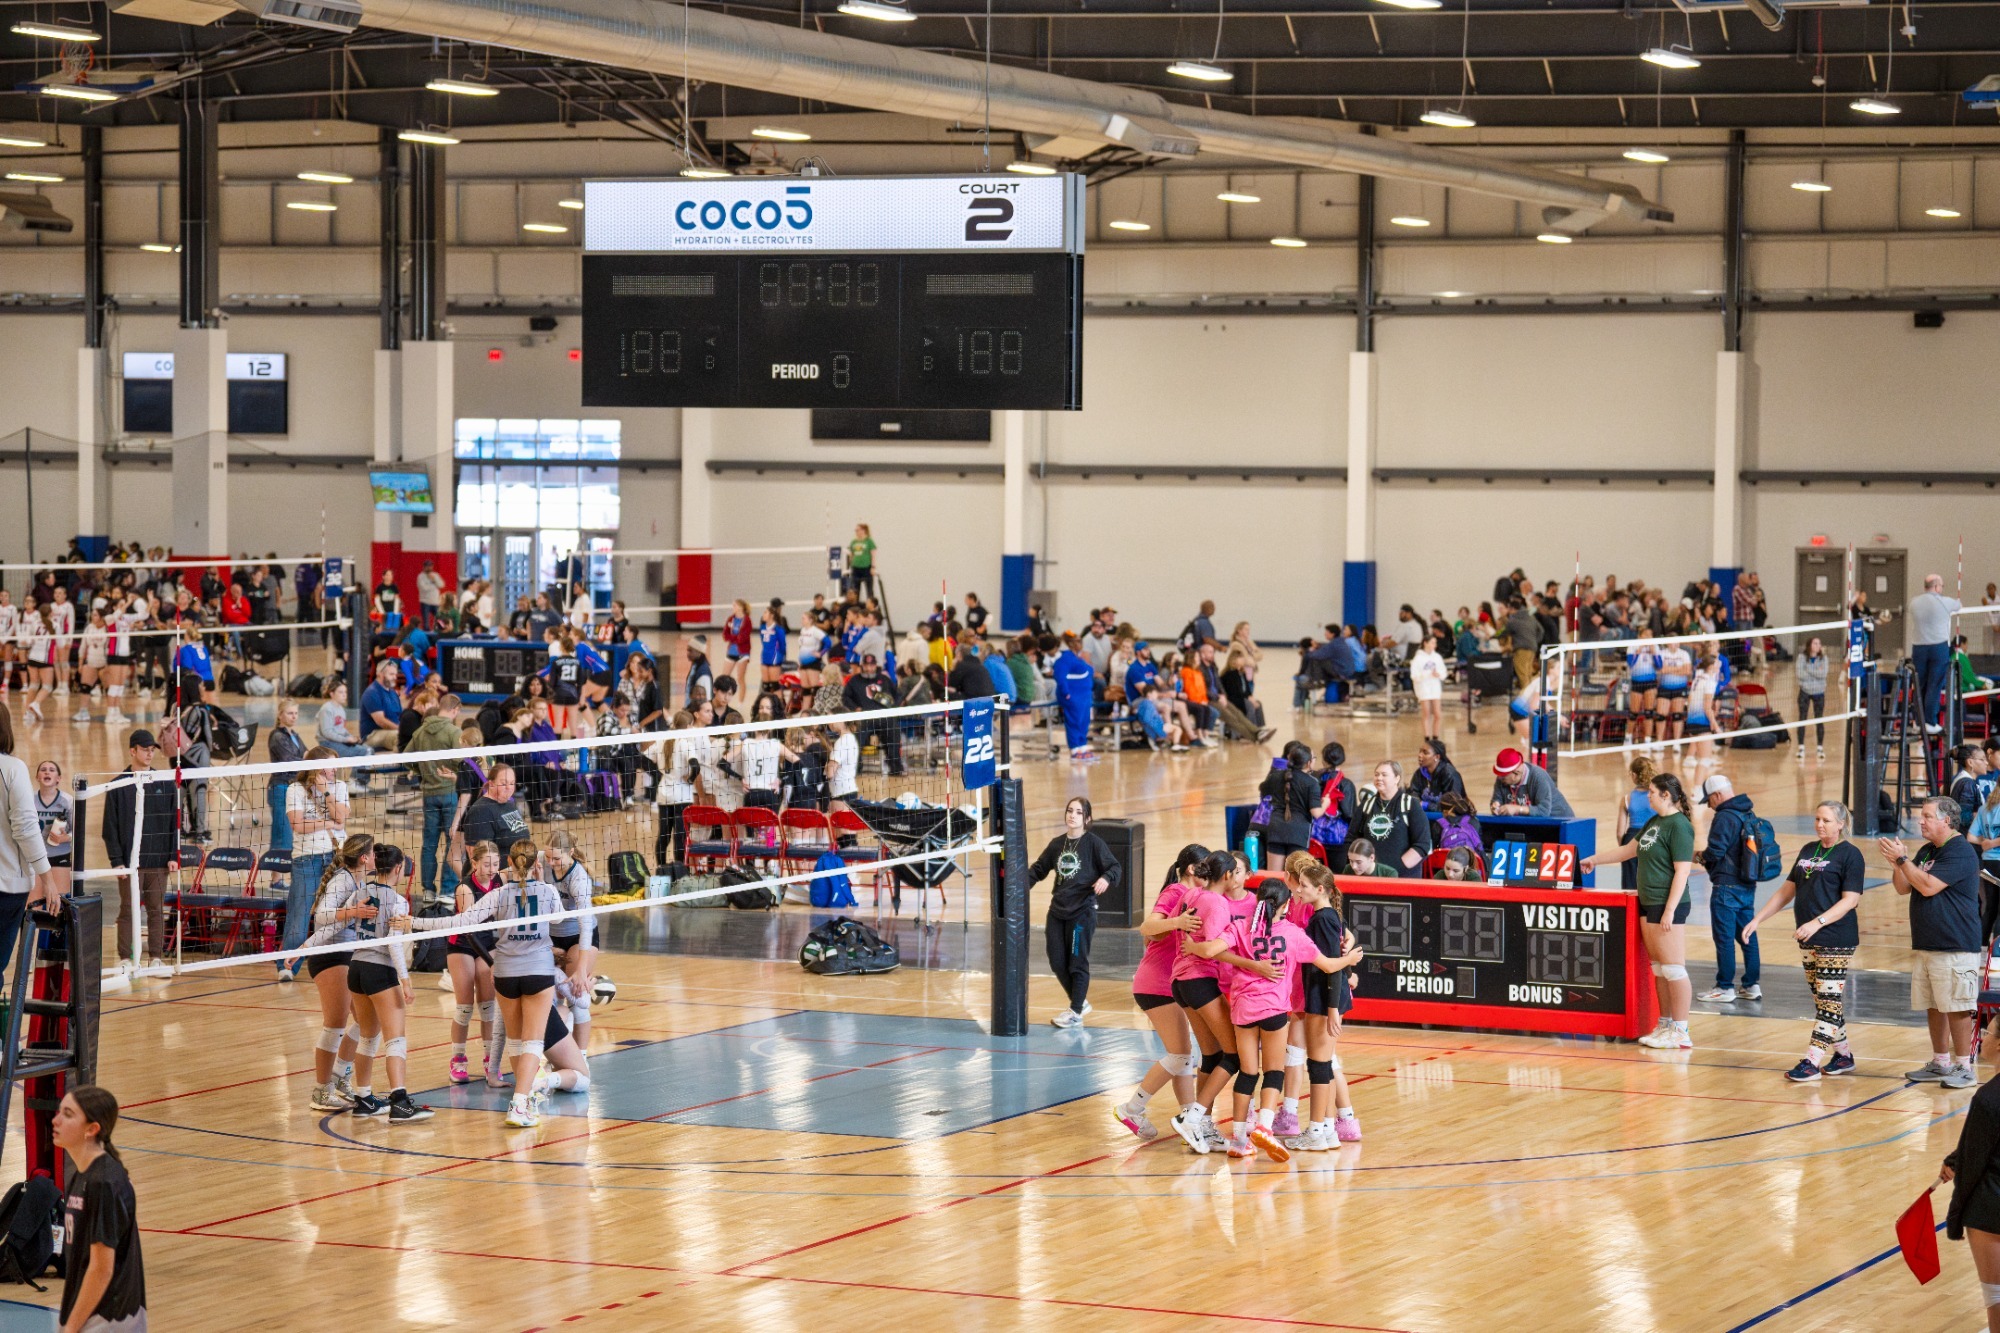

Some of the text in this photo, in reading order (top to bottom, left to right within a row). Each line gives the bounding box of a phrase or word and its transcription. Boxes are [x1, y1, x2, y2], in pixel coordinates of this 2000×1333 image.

[959, 183, 1020, 194] COURT
[965, 197, 1014, 241] 2
[674, 236, 731, 245] HYDRATION
[741, 236, 813, 244] ELECTROLYTES
[248, 361, 272, 376] 12
[771, 363, 820, 379] PERIOD
[454, 647, 484, 659] HOME
[560, 665, 577, 680] 21
[468, 683, 494, 693] BONUS
[965, 734, 995, 764] 22
[755, 759, 763, 776] 5
[1492, 848, 1523, 876] 21
[1529, 848, 1538, 862] 2
[1540, 849, 1574, 877] 22
[516, 895, 538, 931] 11
[1522, 904, 1610, 931] VISITOR
[1253, 935, 1287, 964] 22
[1399, 959, 1430, 974] POSS
[1397, 974, 1454, 995] PERIOD
[1508, 984, 1563, 1005] BONUS
